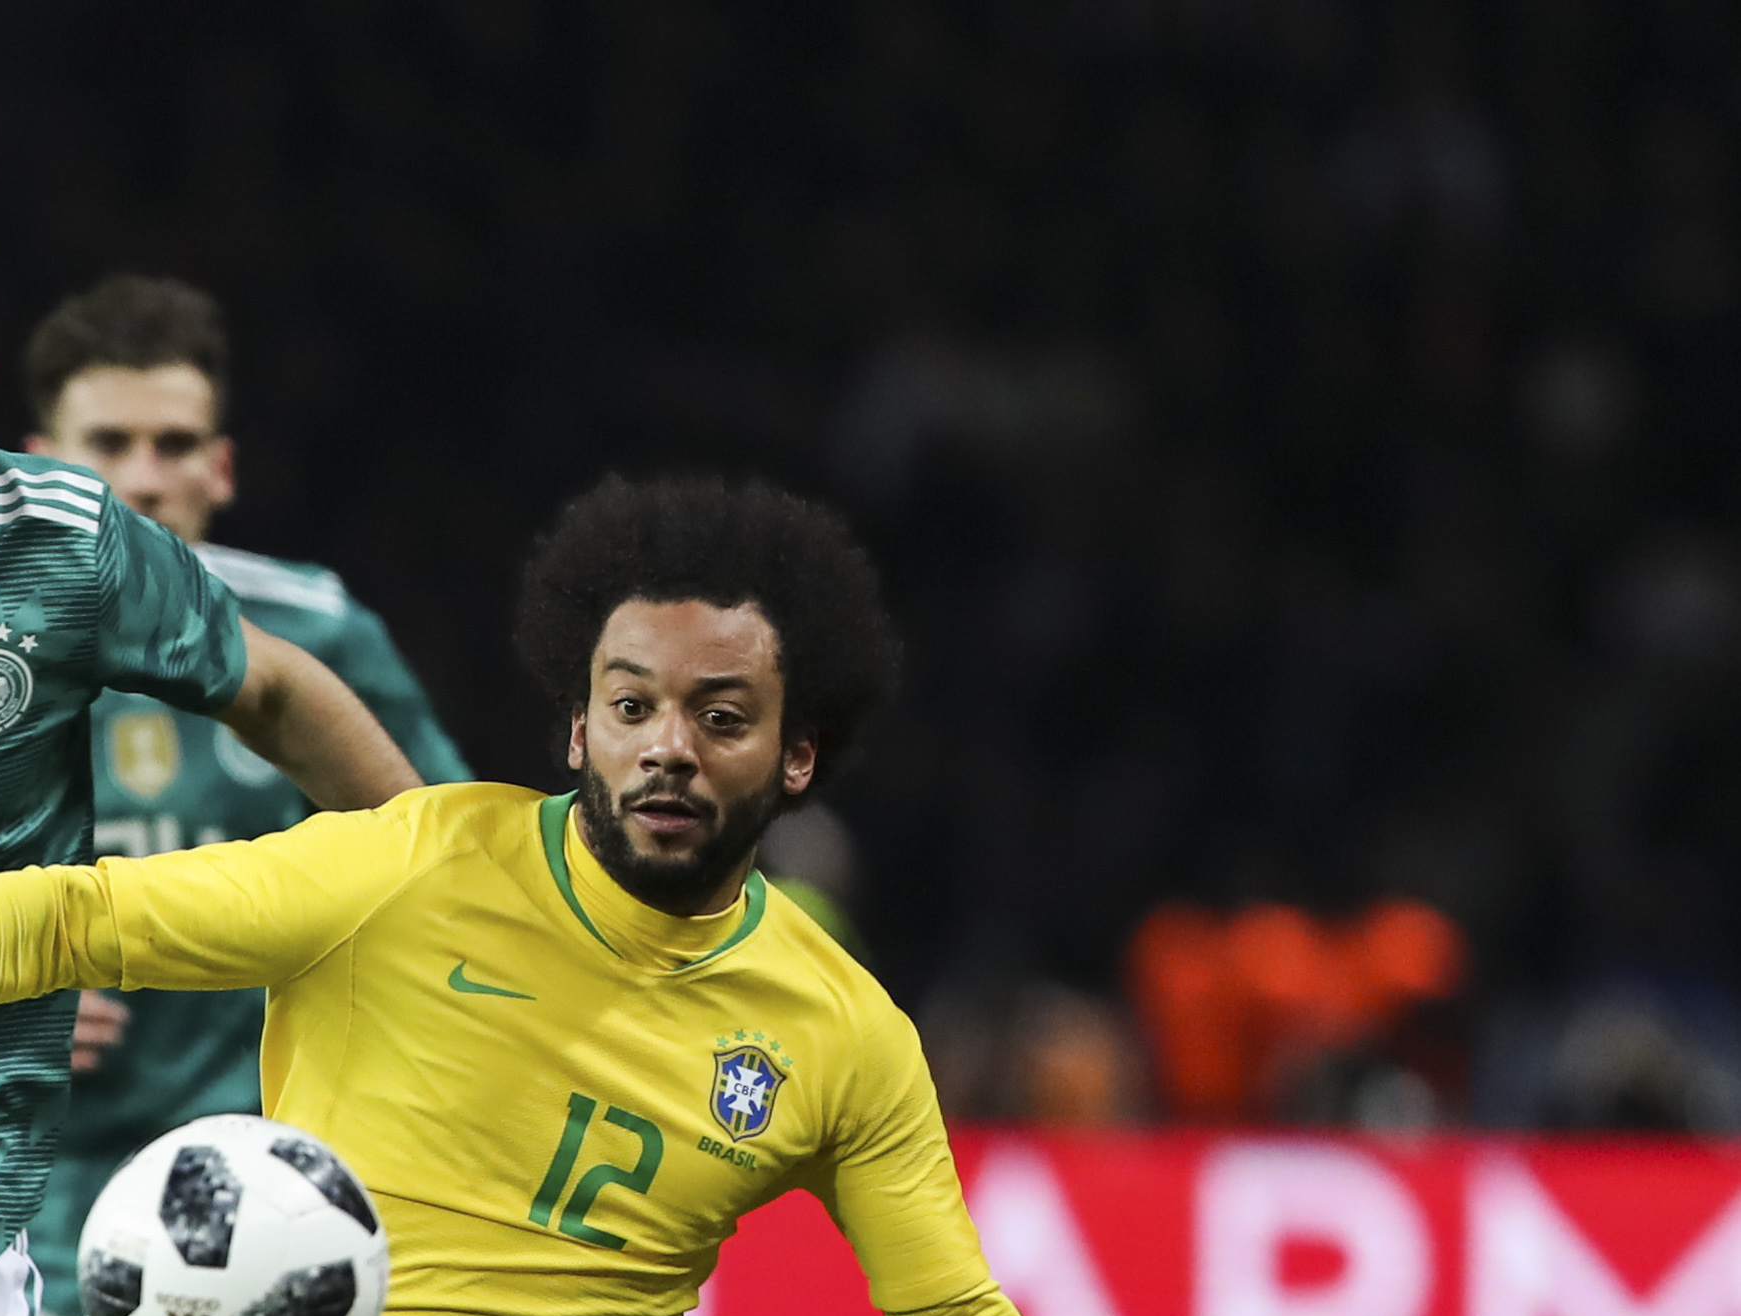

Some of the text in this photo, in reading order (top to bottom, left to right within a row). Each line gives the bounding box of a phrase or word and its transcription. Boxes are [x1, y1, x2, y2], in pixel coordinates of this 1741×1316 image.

[733, 1082, 757, 1098] CBF
[696, 1136, 759, 1171] BRASIL
[528, 1092, 664, 1251] 12
